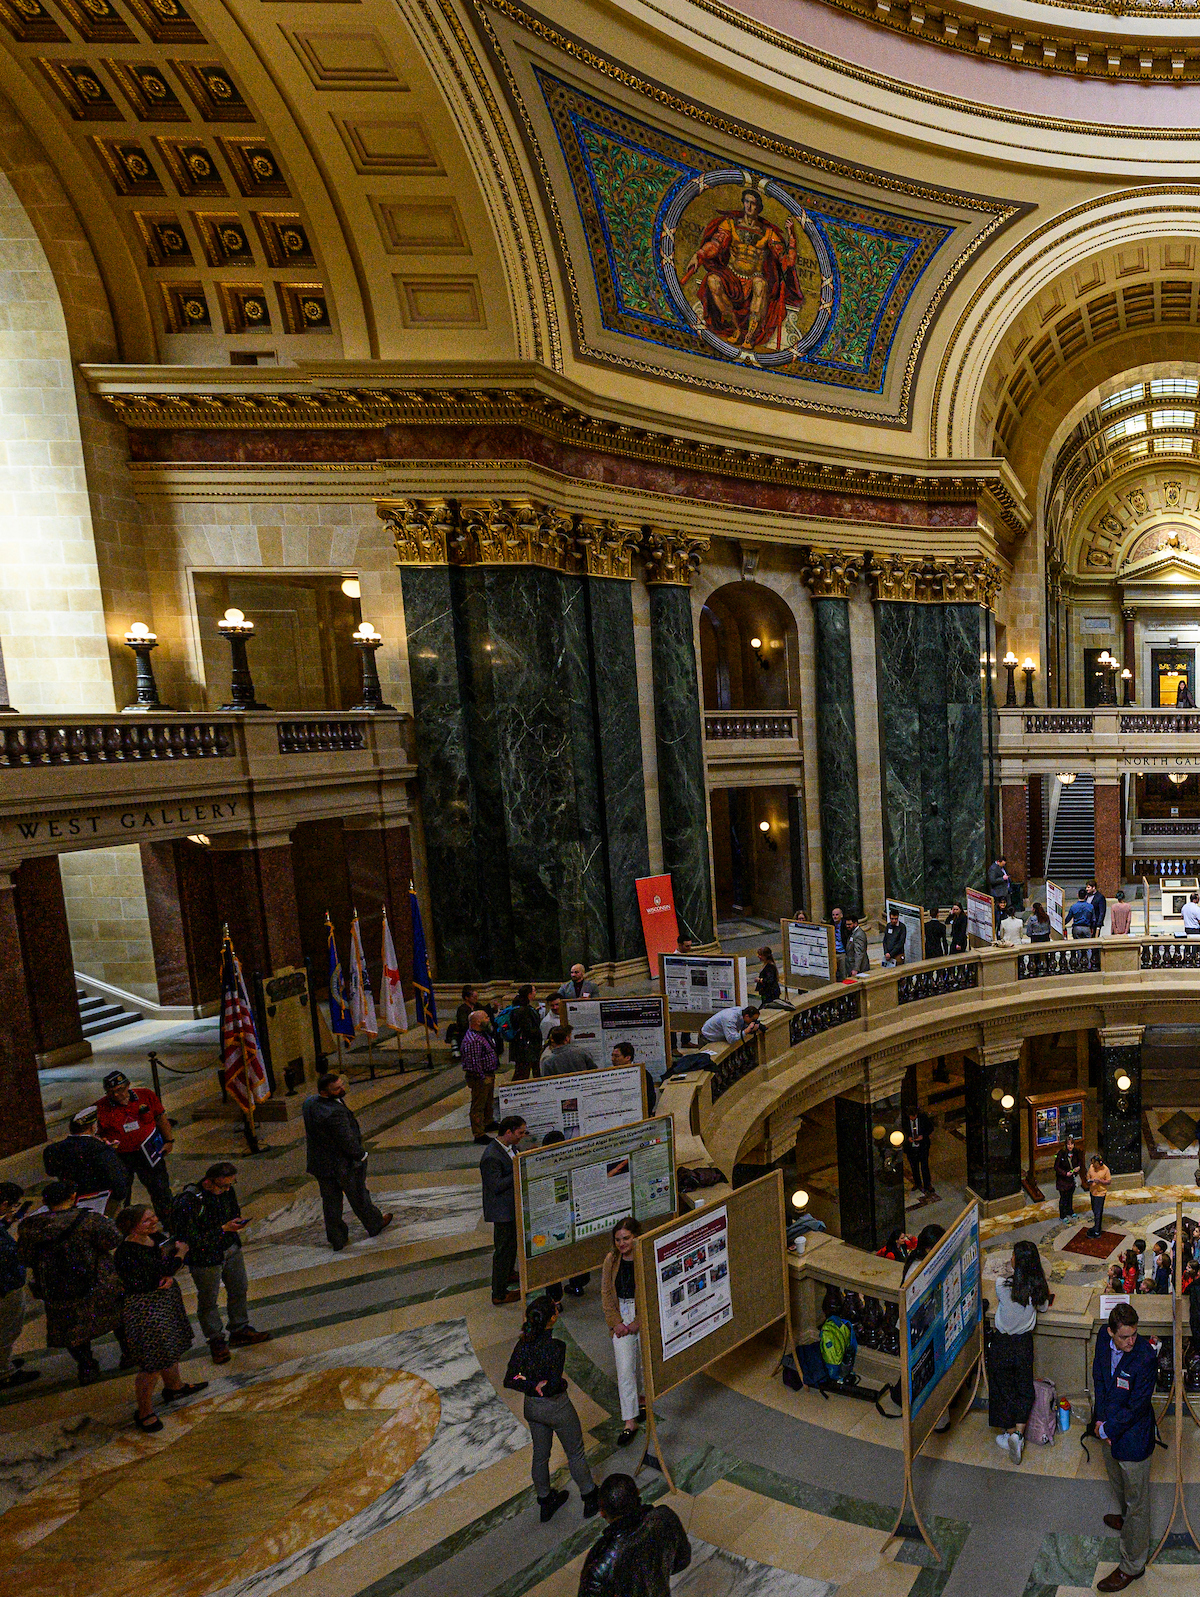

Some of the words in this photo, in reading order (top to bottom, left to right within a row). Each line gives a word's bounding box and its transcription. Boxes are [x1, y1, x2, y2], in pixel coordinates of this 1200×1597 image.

[797, 256, 818, 270] ERN
[798, 268, 816, 281] NT
[1124, 756, 1168, 766] NORTH
[17, 816, 101, 839] WEST
[120, 802, 238, 828] GALLERY
[527, 1082, 549, 1090] cranberry
